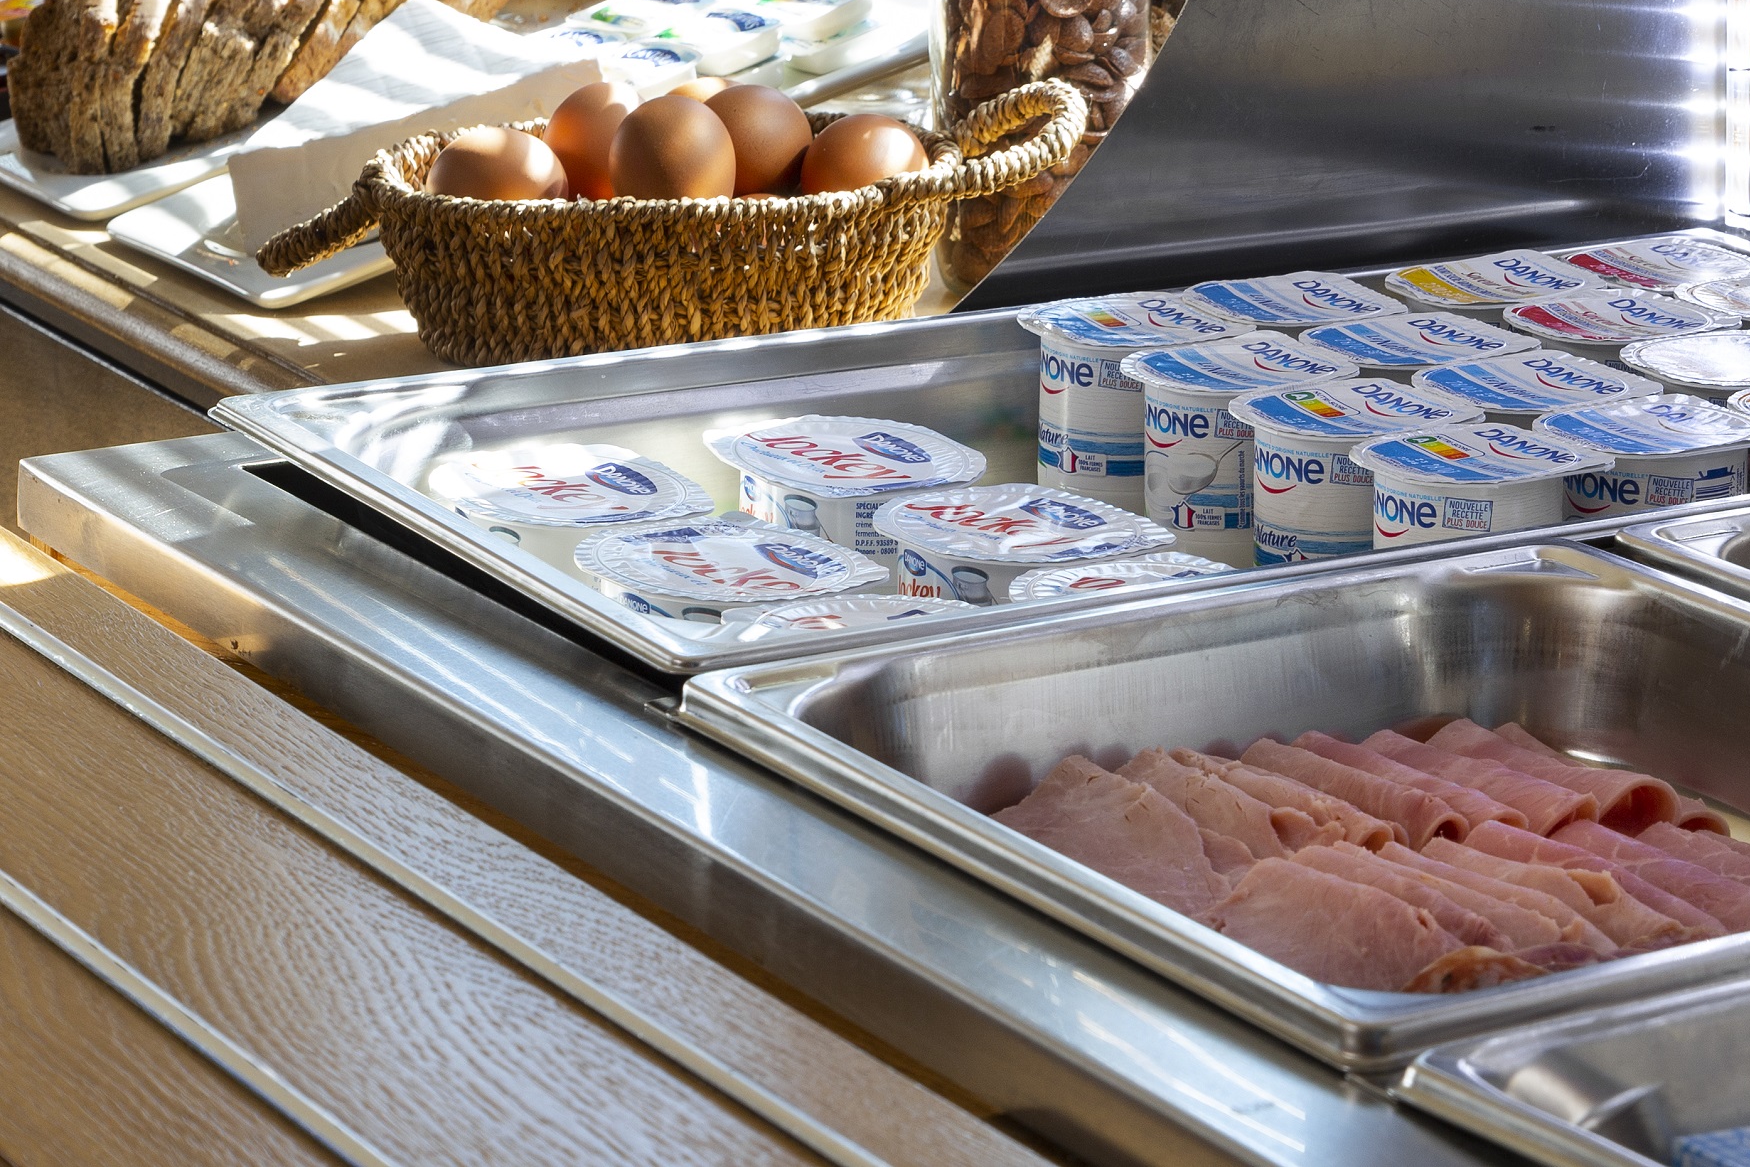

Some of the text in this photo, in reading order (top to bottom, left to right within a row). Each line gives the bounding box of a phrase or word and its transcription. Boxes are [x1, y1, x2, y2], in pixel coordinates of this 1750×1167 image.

[1493, 258, 1580, 290] DANONE
[1293, 280, 1382, 313] DANONE
[1607, 298, 1704, 330] DANONE
[1407, 319, 1506, 350] DANONE
[1040, 350, 1094, 387] NONE
[1242, 341, 1338, 375] DANONE
[1102, 378, 1140, 390] PLUS DOUCE
[1523, 358, 1627, 395] DANONE
[1351, 384, 1453, 420] DANONE
[1144, 401, 1209, 439] NONE
[1218, 427, 1254, 438] PLUS DOUC
[744, 433, 912, 480] Jockey
[870, 434, 926, 462] DANONE
[1473, 428, 1579, 465] DANONE
[1334, 474, 1374, 484] PLUS DOUCE
[1652, 479, 1690, 490] NOUVELLE
[1654, 487, 1686, 497] RECETTE
[1374, 489, 1437, 529] NONE
[1449, 500, 1489, 512] NOUVELLE
[1649, 494, 1666, 504] PLUS
[1446, 517, 1488, 529] PLUS DOUCE
[1451, 509, 1483, 520] RECETTE
[1256, 524, 1297, 548] Nature
[904, 552, 926, 571] DANONE
